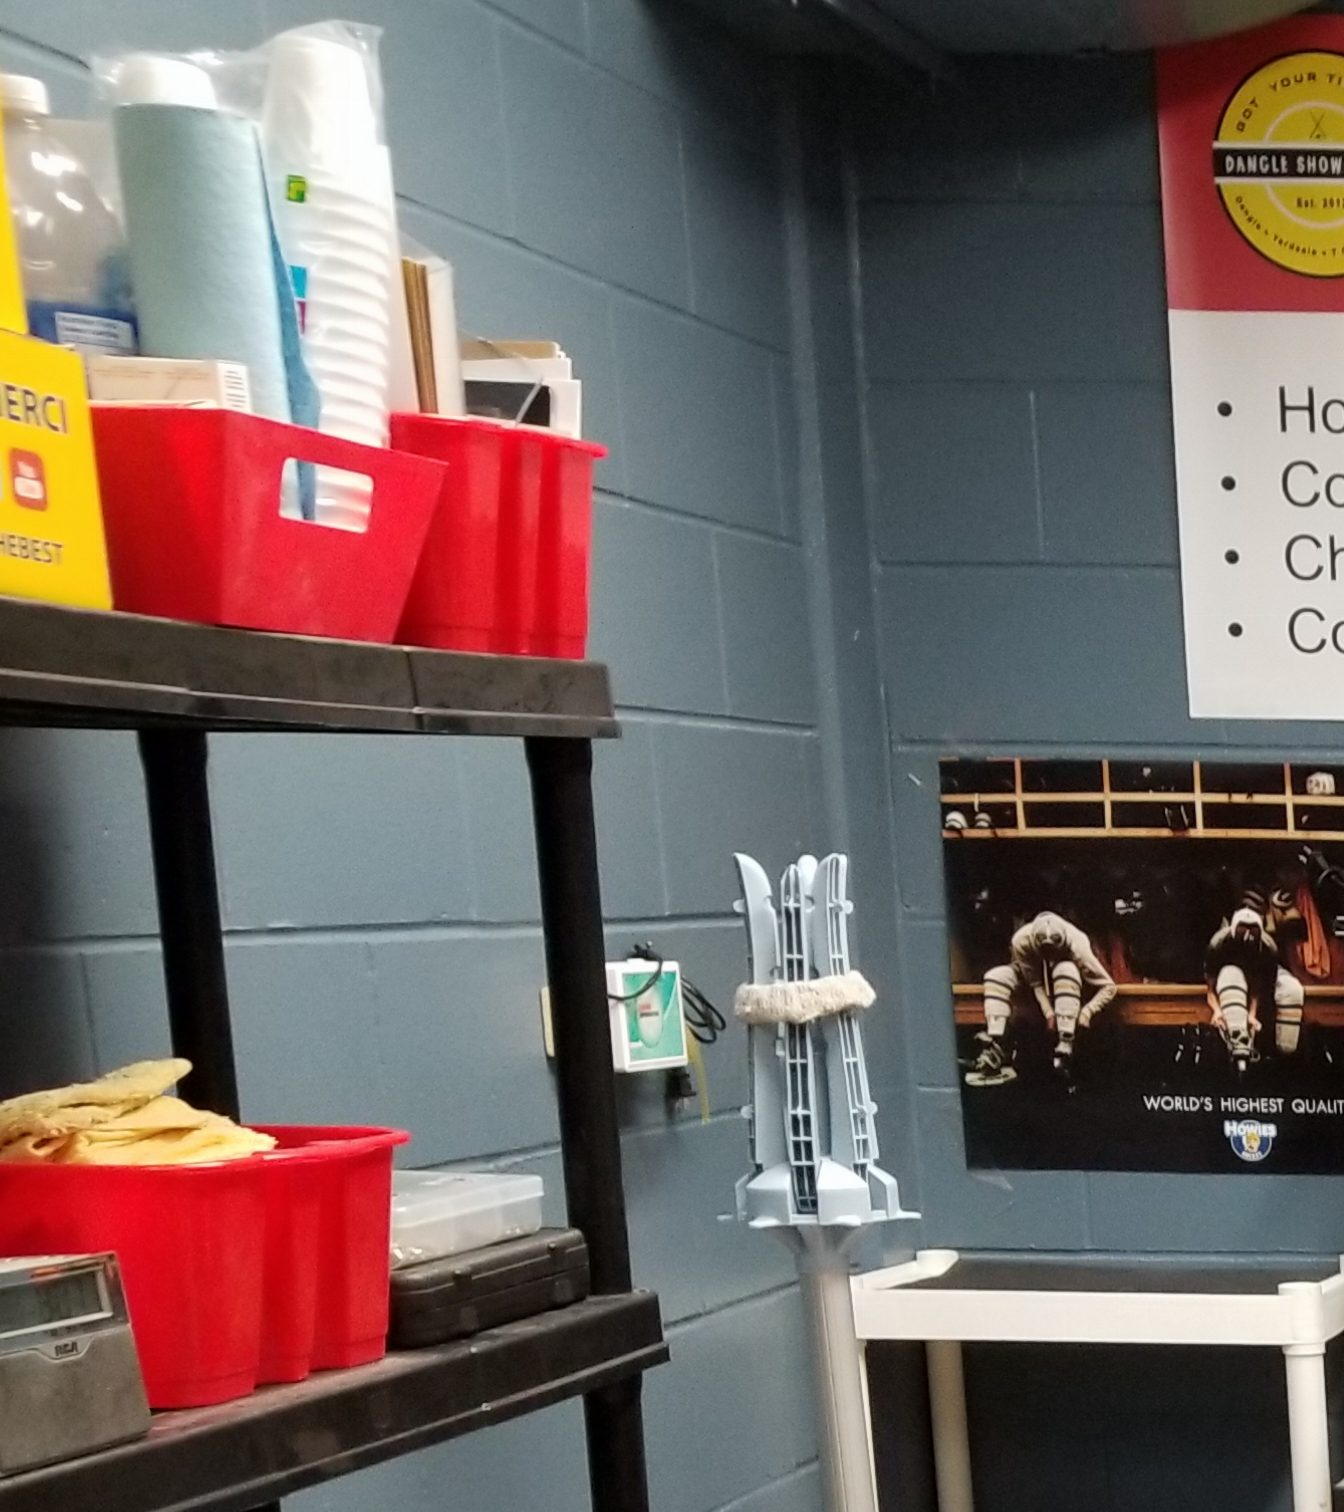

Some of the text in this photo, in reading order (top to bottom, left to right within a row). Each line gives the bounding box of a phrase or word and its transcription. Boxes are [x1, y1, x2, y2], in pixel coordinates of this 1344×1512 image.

[1236, 97, 1259, 133] GOT
[1269, 72, 1317, 93] YOUR
[1225, 154, 1288, 174] DANGLE
[1296, 155, 1343, 176] SHOW
[0, 383, 68, 434] ERCI
[1143, 1095, 1213, 1112] WORLD'S
[1220, 1096, 1284, 1114] HIGHEST
[1224, 1119, 1278, 1138] HOWIES
[54, 1341, 79, 1357] RCA
